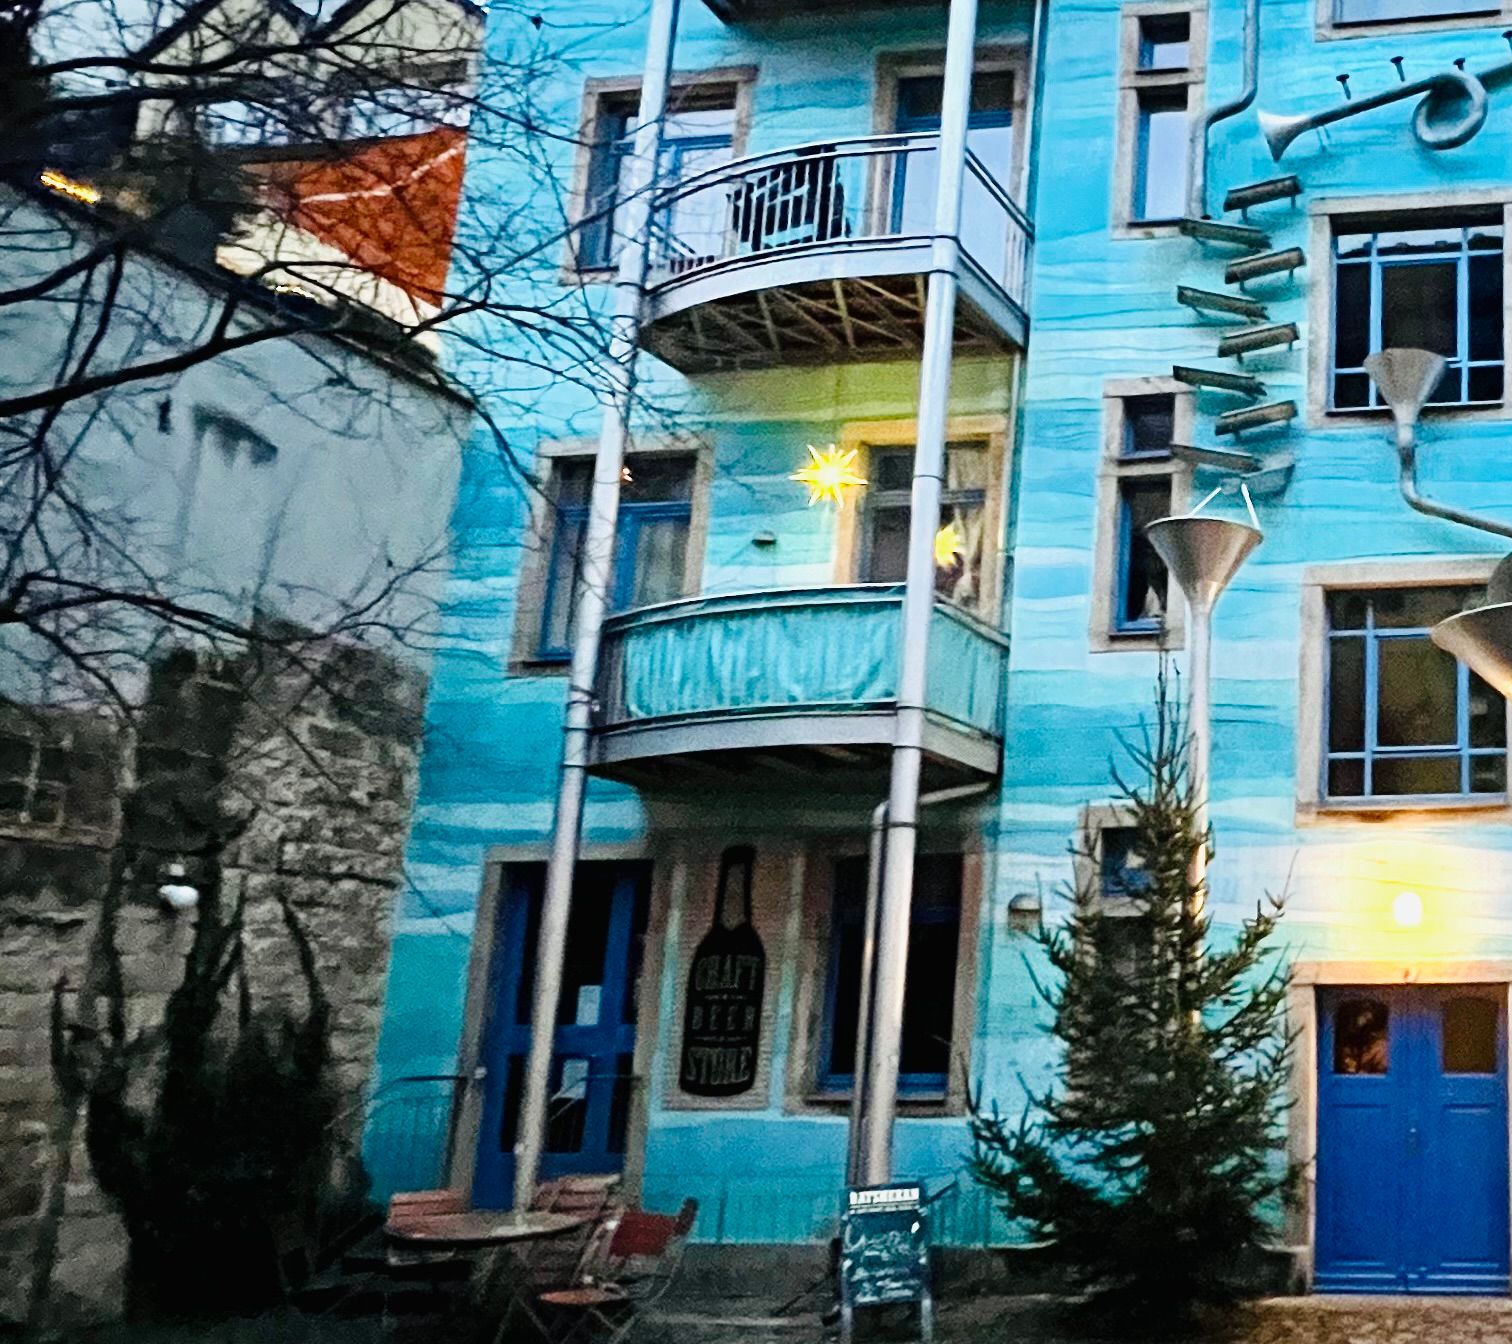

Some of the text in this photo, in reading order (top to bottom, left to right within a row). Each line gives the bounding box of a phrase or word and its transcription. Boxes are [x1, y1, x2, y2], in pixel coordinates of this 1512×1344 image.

[695, 954, 760, 991] CRAFT
[691, 1005, 756, 1031] BEER
[685, 1045, 753, 1085] STORE
